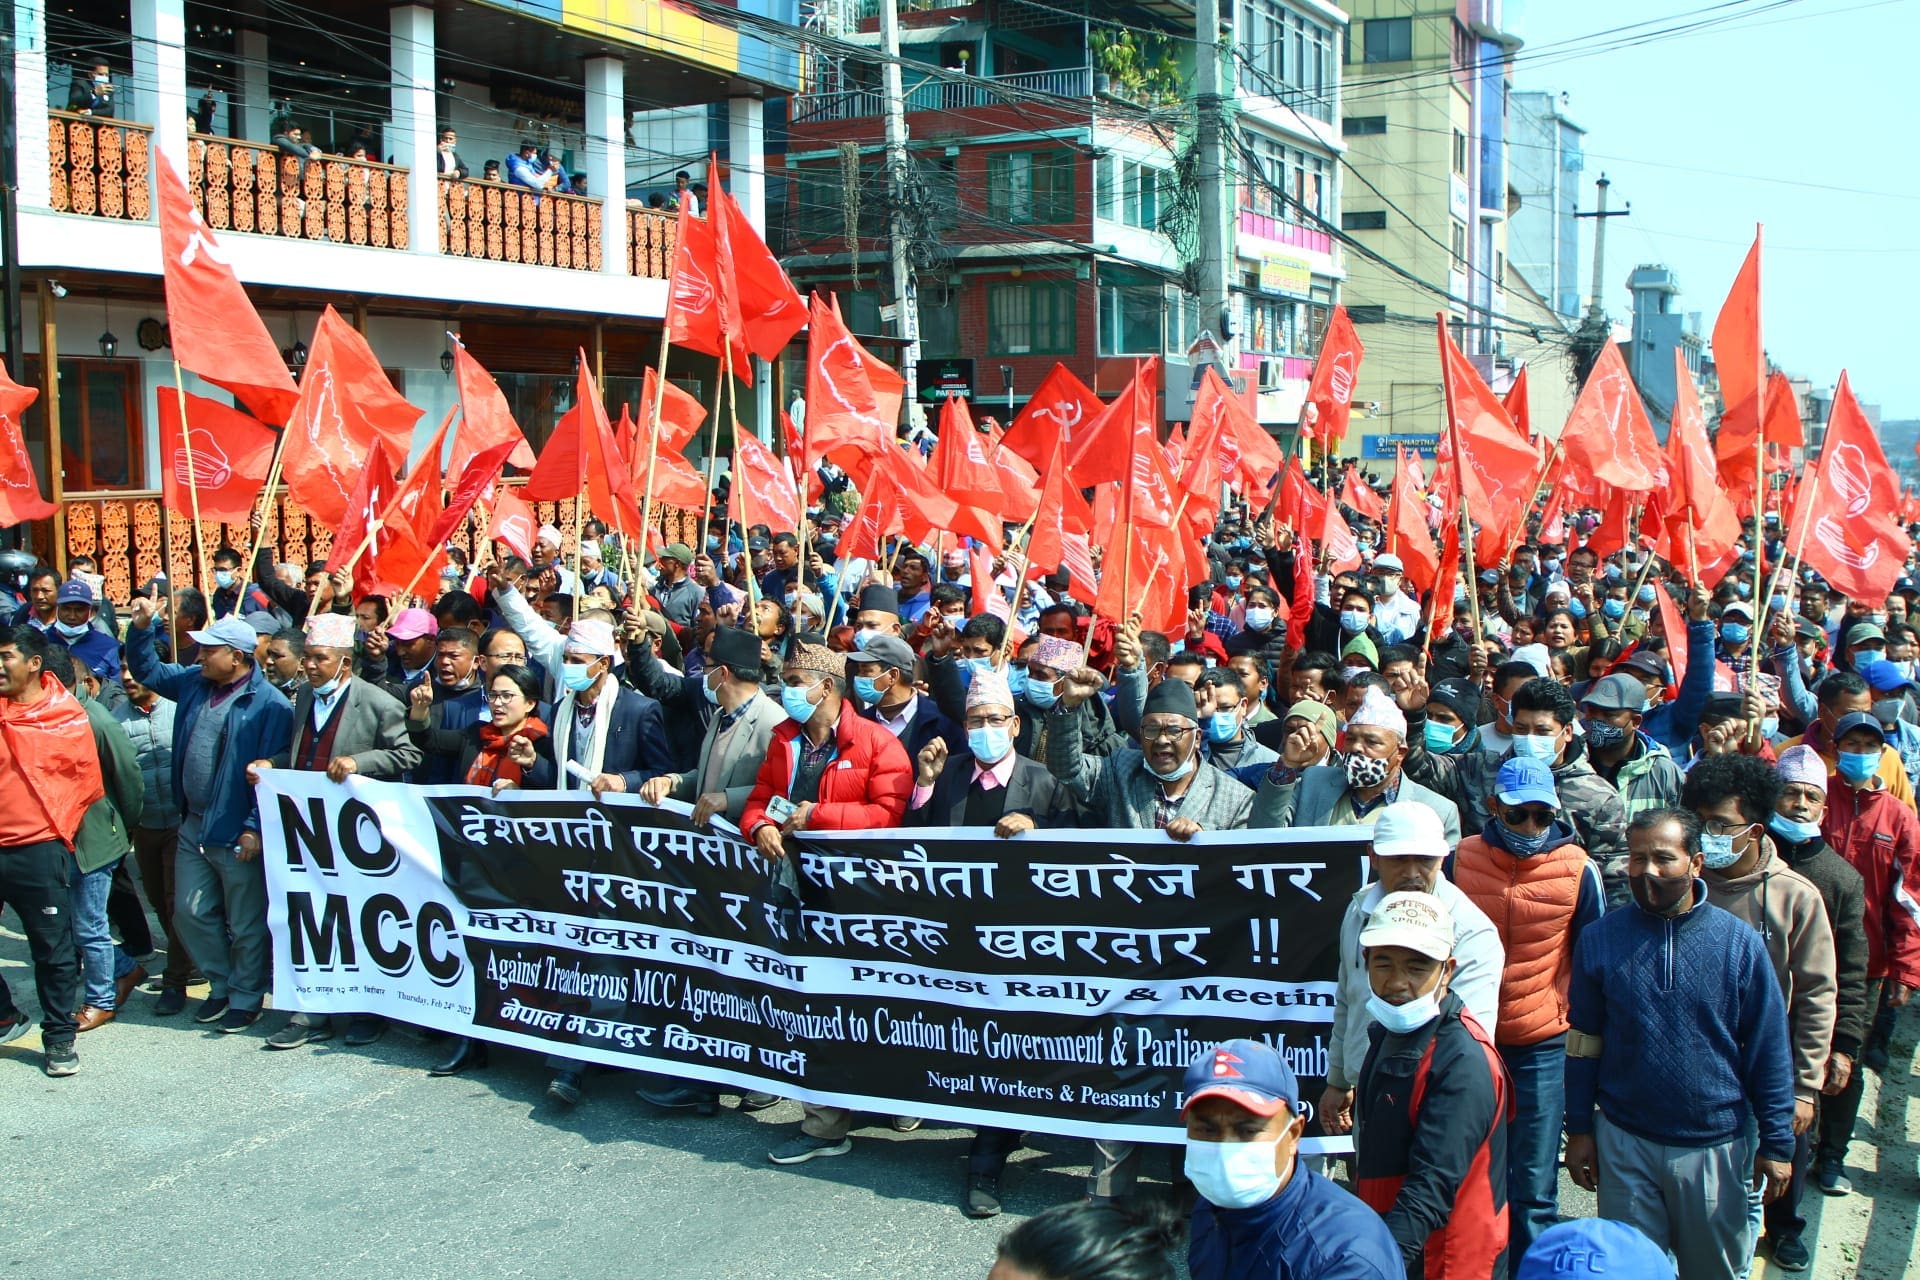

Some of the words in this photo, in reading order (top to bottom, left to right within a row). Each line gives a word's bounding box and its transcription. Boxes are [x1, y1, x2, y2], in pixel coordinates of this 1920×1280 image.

[277, 793, 401, 878] NO
[460, 805, 613, 851] देशघाती
[631, 825, 774, 877] एमसीस
[1029, 854, 1200, 903] खारेज
[1232, 862, 1327, 902] गर
[286, 891, 465, 988] MCC
[562, 869, 697, 923] सरकार
[720, 892, 750, 932] र
[975, 924, 1211, 967] खबरदार
[1250, 918, 1280, 965] !!
[565, 924, 658, 950] जुलुस
[671, 937, 732, 965] तथा
[745, 953, 808, 982] सभा
[431, 998, 443, 1008] Feb
[456, 1004, 472, 1015] 2022
[487, 949, 542, 990] Against
[544, 955, 629, 1002] Treacherous
[631, 968, 677, 1010] MCC
[680, 976, 762, 1024] Agreement
[761, 995, 846, 1042] Organized
[849, 1007, 869, 1044] to
[874, 1006, 947, 1051] Caution
[951, 1016, 979, 1057] the
[983, 1019, 1103, 1067] Government
[1110, 1026, 1128, 1068] &
[851, 966, 990, 996] Protest
[1005, 980, 1111, 1007] Rally
[1124, 987, 1161, 1001] &
[1180, 984, 1336, 1007] Meetin
[500, 998, 566, 1031] नेपाल
[566, 1014, 656, 1048] मजदुर
[663, 1023, 751, 1063] किसान
[758, 1046, 808, 1078] पार्टी
[927, 1070, 975, 1094] Nepal
[980, 1075, 1054, 1101] Workers
[1059, 1085, 1075, 1102] &
[1080, 1085, 1167, 1110] Peasants'
[1553, 1246, 1607, 1273] UFC
